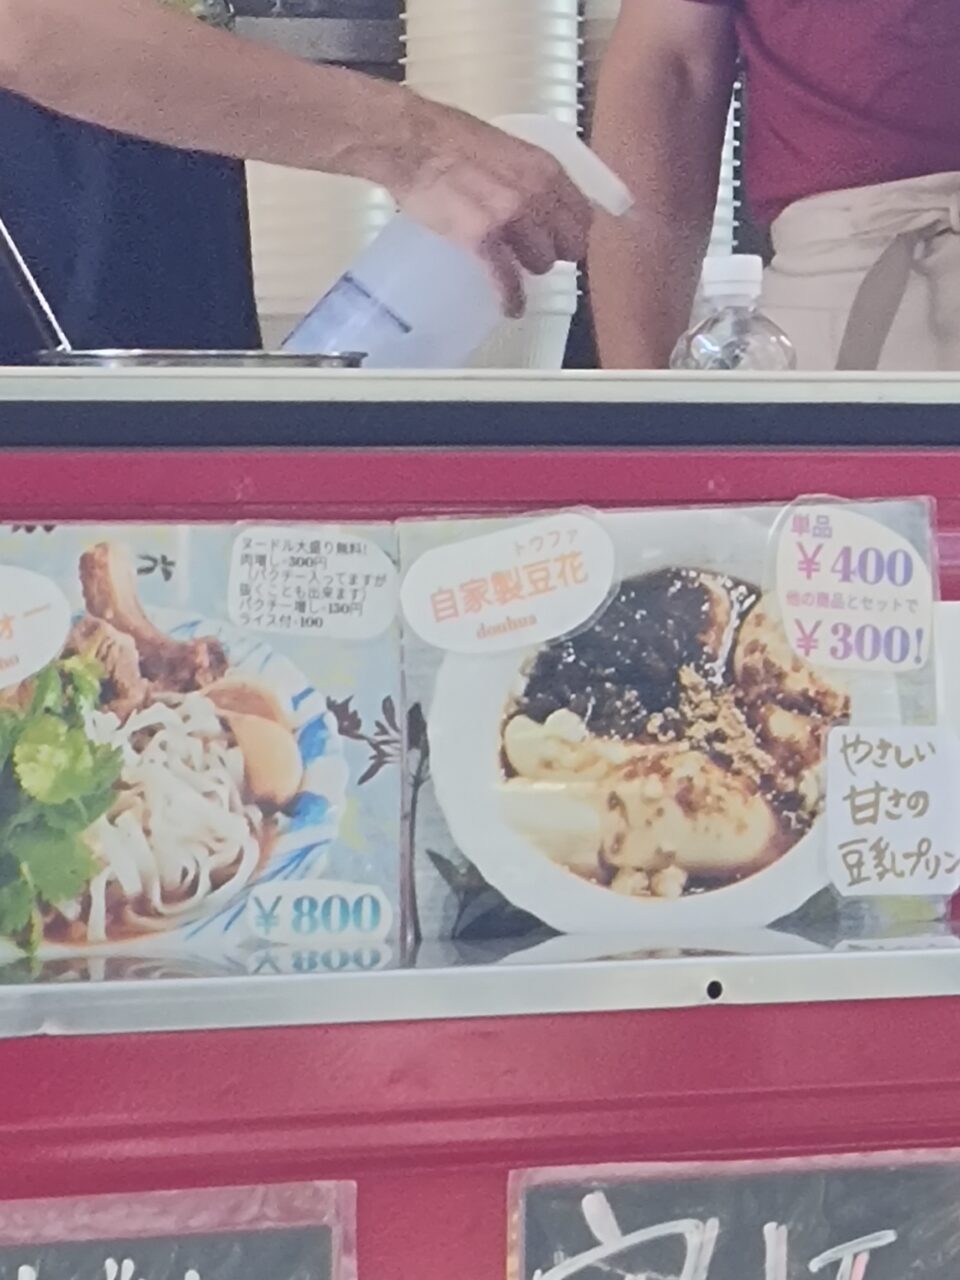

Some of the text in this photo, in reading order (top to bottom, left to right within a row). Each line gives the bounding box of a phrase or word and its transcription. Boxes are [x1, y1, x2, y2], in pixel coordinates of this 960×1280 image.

[792, 514, 832, 539] 単品
[797, 542, 914, 587] ¥400
[430, 550, 590, 623] 自家製豆花
[786, 591, 918, 614] 他の商品とセットで
[794, 618, 924, 665] ¥300!
[840, 734, 936, 776] やさしい
[842, 781, 930, 825] 甘さの
[254, 894, 381, 934] ¥800
